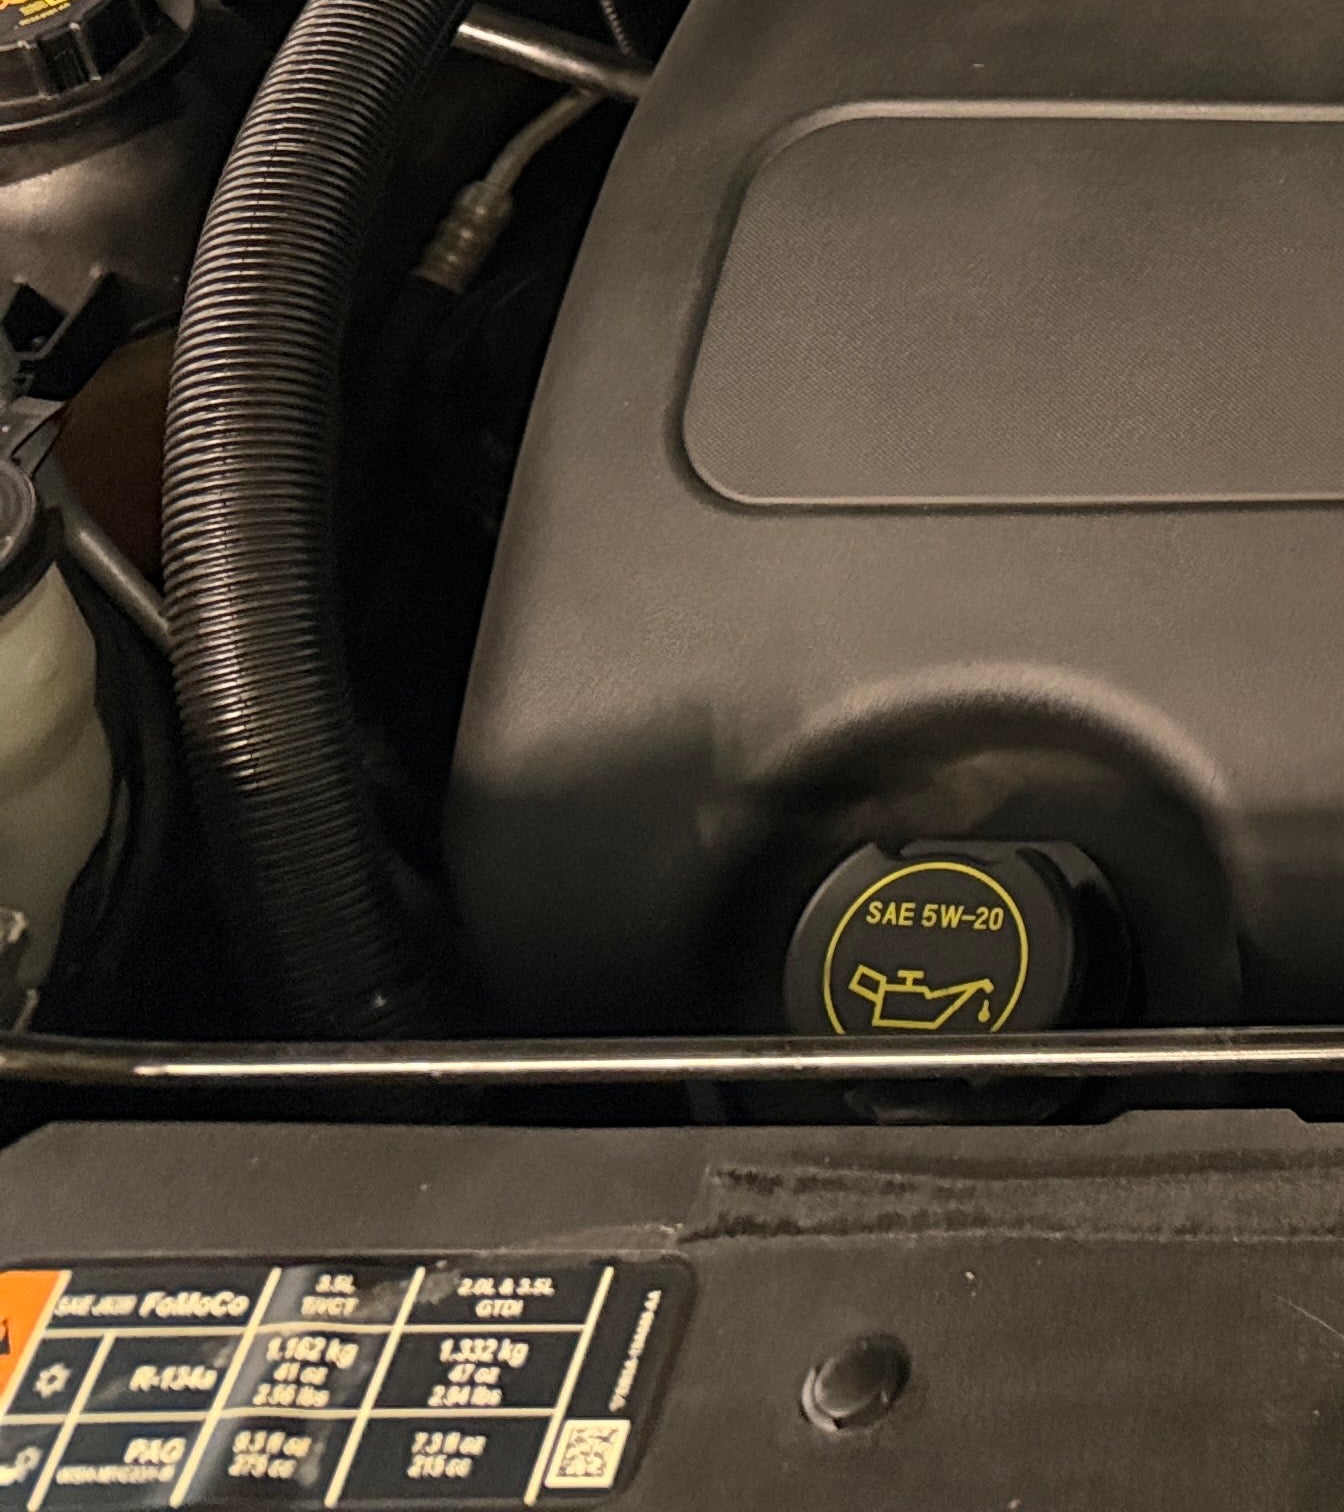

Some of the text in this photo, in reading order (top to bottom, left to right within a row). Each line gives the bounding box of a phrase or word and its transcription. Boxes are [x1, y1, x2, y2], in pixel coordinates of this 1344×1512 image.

[866, 901, 1005, 932] SAE 5W-20
[457, 1276, 555, 1296] 2.0L & 3.5L
[139, 1292, 251, 1318] FoMoCo
[325, 1337, 359, 1369] kg
[499, 1338, 530, 1368] kg
[130, 1364, 218, 1392] R-134a
[273, 1363, 300, 1382] 41
[448, 1363, 474, 1382] 47
